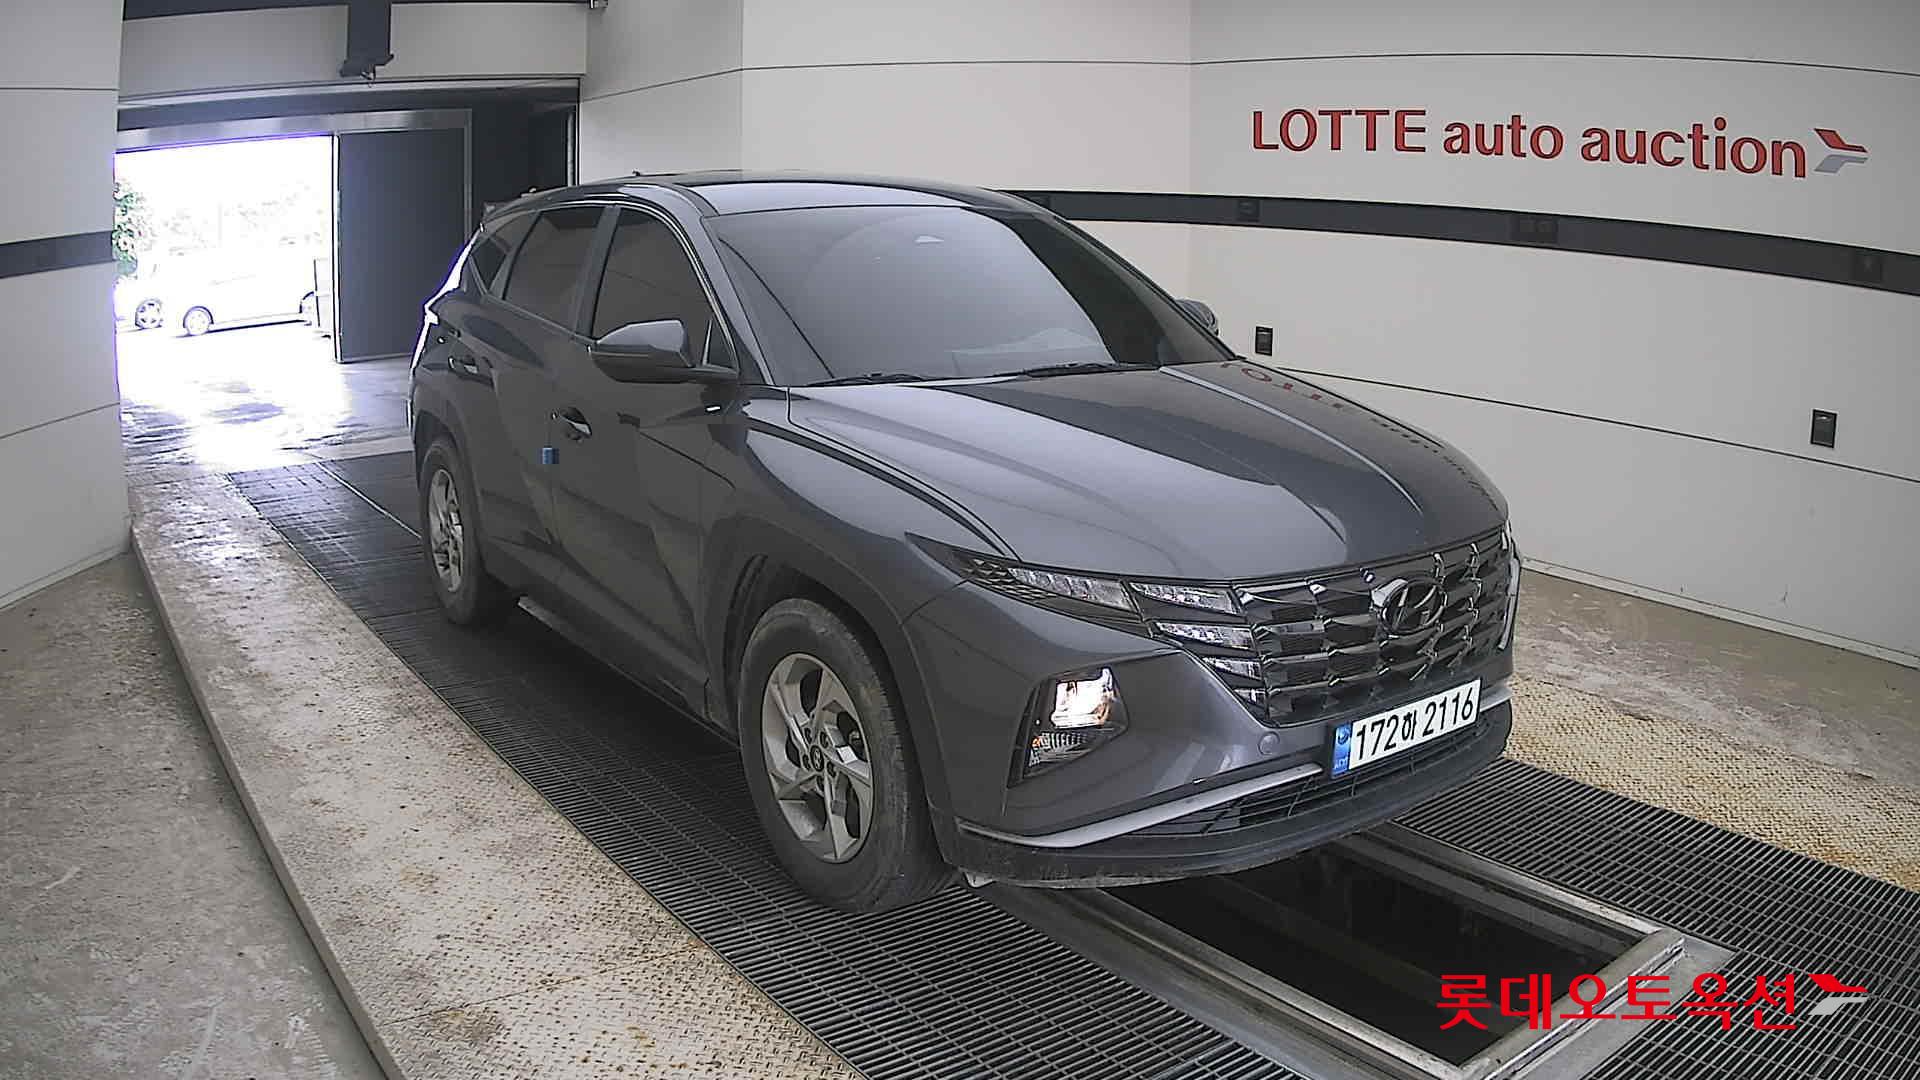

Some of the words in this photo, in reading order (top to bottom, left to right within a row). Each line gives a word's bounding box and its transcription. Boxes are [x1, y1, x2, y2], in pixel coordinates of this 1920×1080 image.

[1253, 109, 1427, 152] LOTTE
[1443, 115, 1564, 160] auto
[1581, 117, 1807, 178] auction
[1356, 709, 1417, 760] 172하
[1422, 687, 1474, 737] 2116
